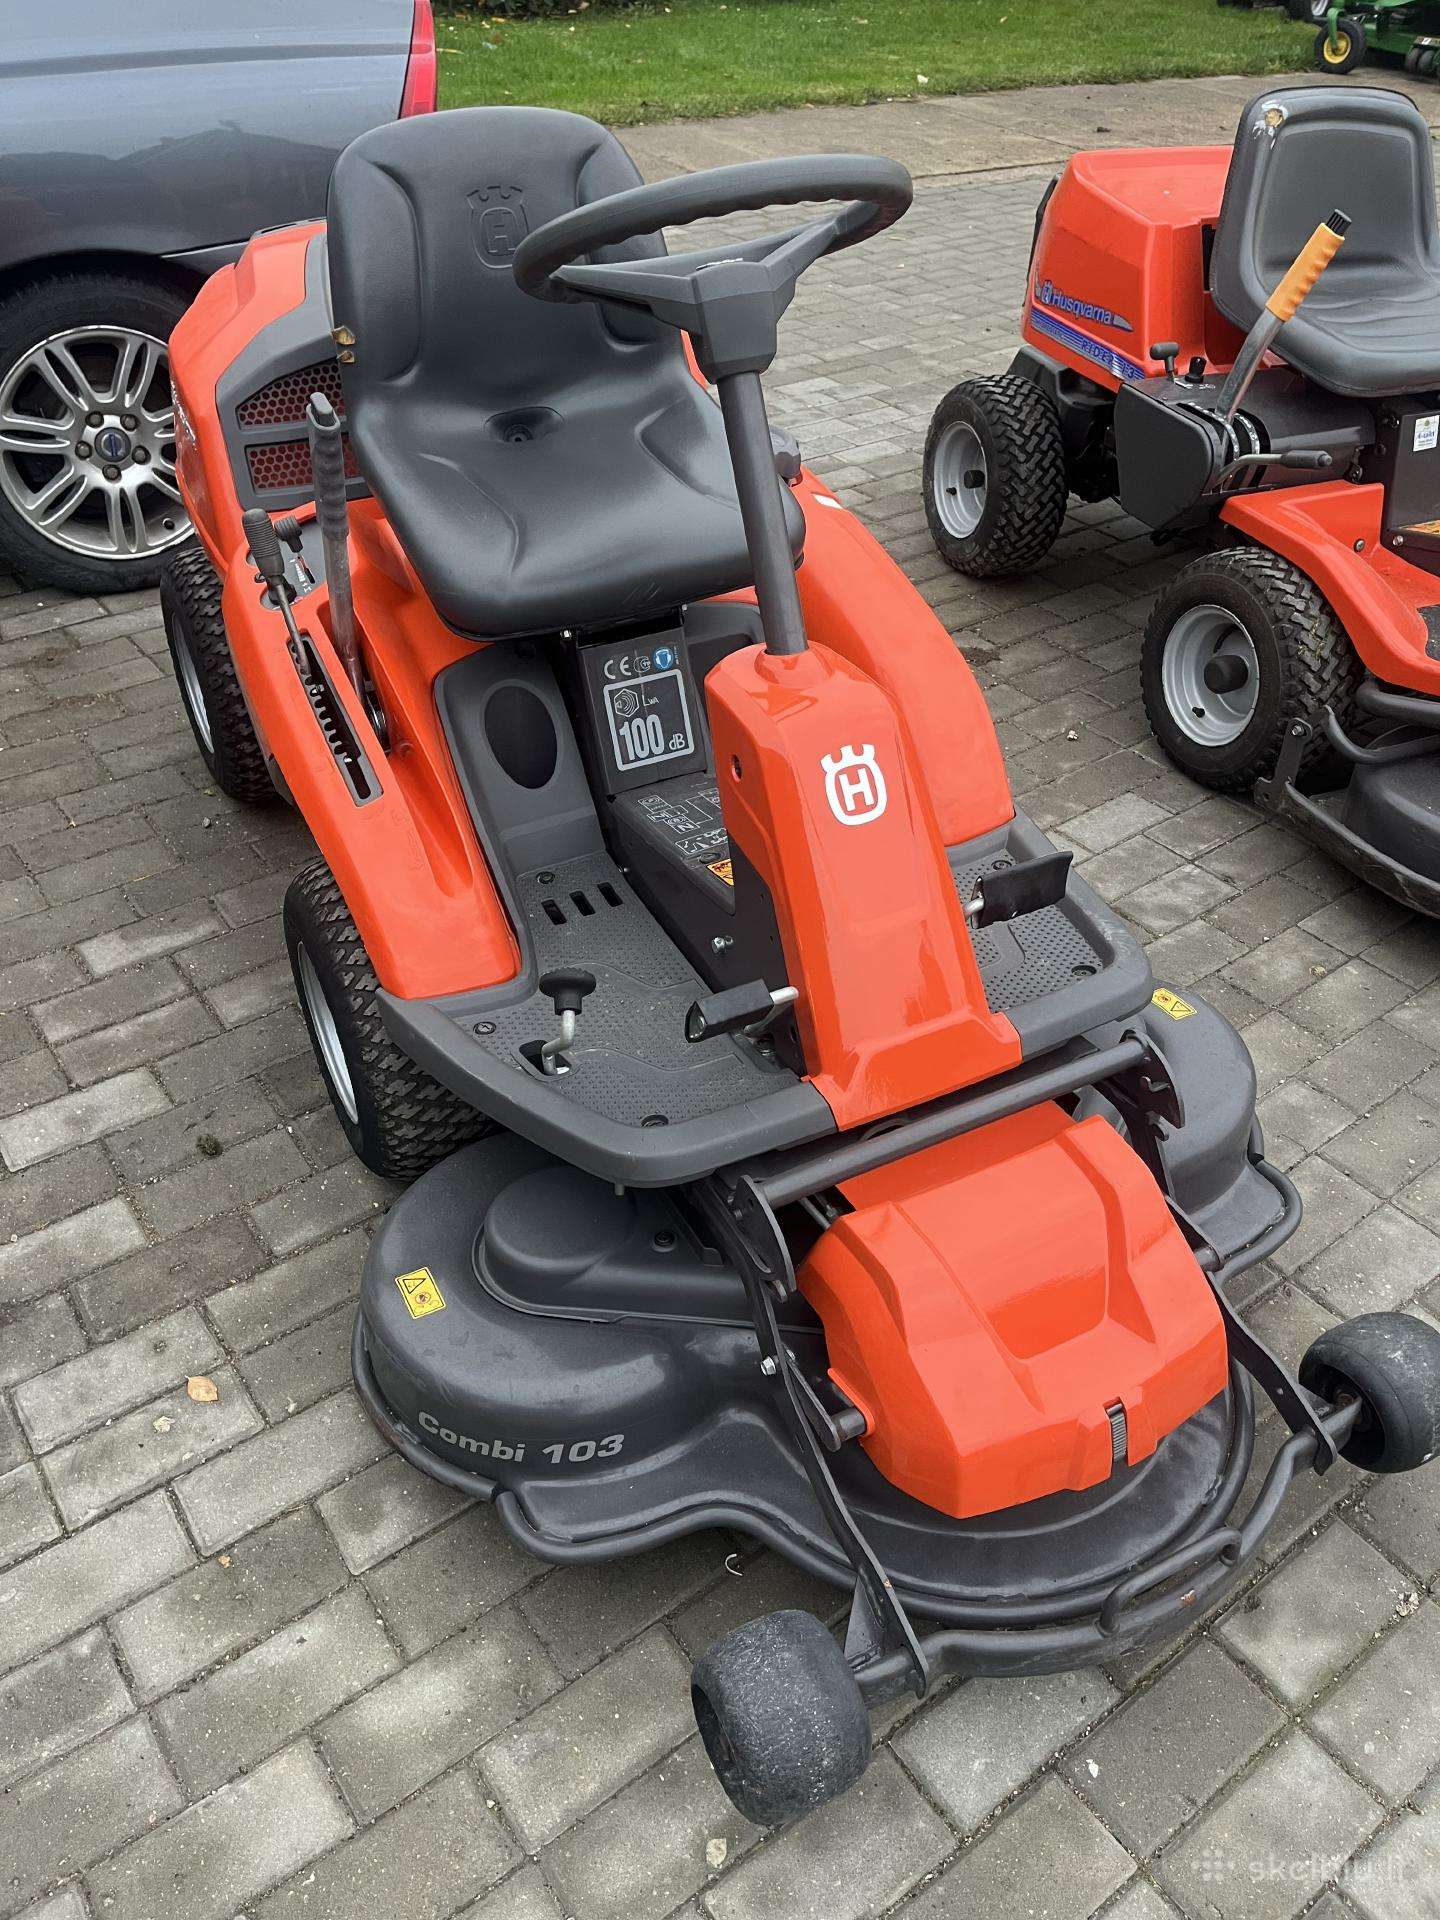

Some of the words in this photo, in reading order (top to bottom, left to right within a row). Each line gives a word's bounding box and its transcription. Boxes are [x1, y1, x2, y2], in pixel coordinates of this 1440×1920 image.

[1052, 290, 1112, 325] Husqvarna
[1081, 339, 1114, 366] RIDER
[603, 656, 632, 680] CE
[618, 714, 665, 761] 100
[668, 733, 686, 750] dB
[418, 1411, 526, 1463] Combi
[542, 1434, 625, 1464] 103
